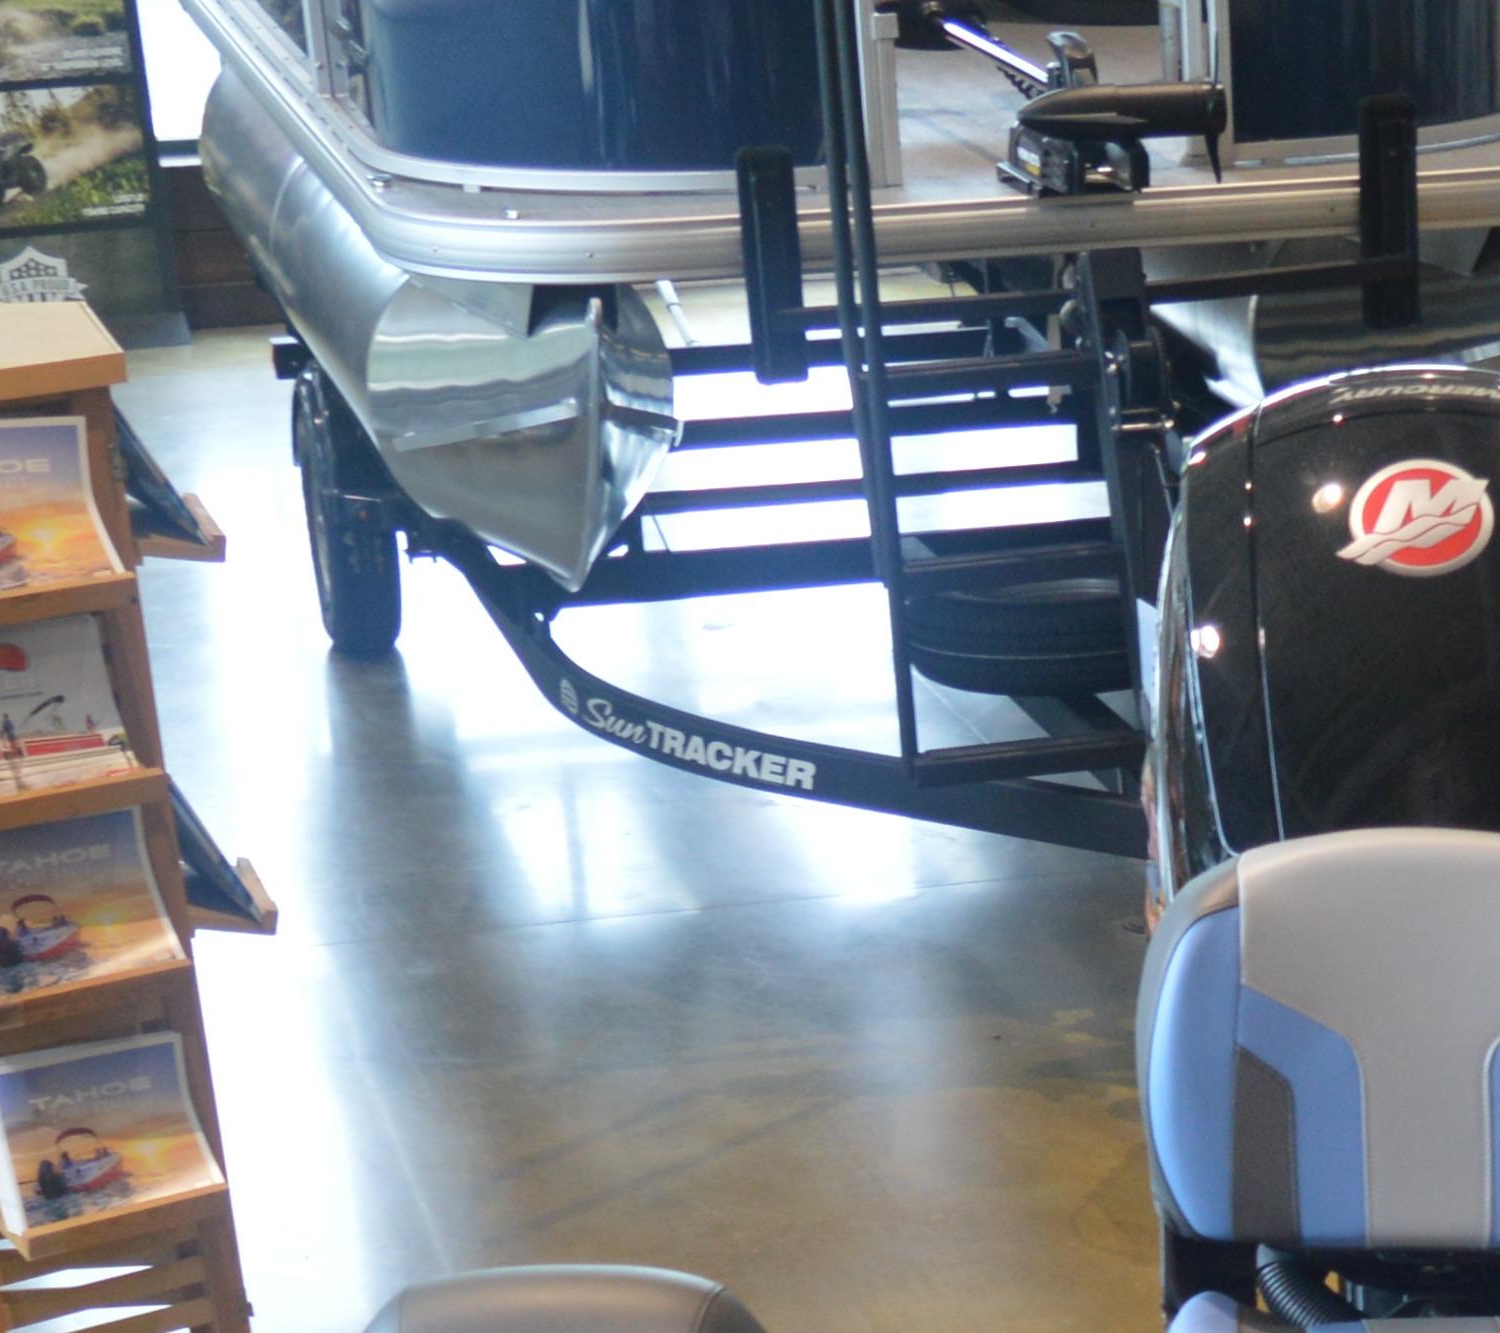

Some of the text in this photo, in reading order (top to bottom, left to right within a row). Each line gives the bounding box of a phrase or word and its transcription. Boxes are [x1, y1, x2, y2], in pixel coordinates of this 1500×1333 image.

[581, 698, 817, 790] Sun TRACKER
[27, 1075, 151, 1112] TAHOE
